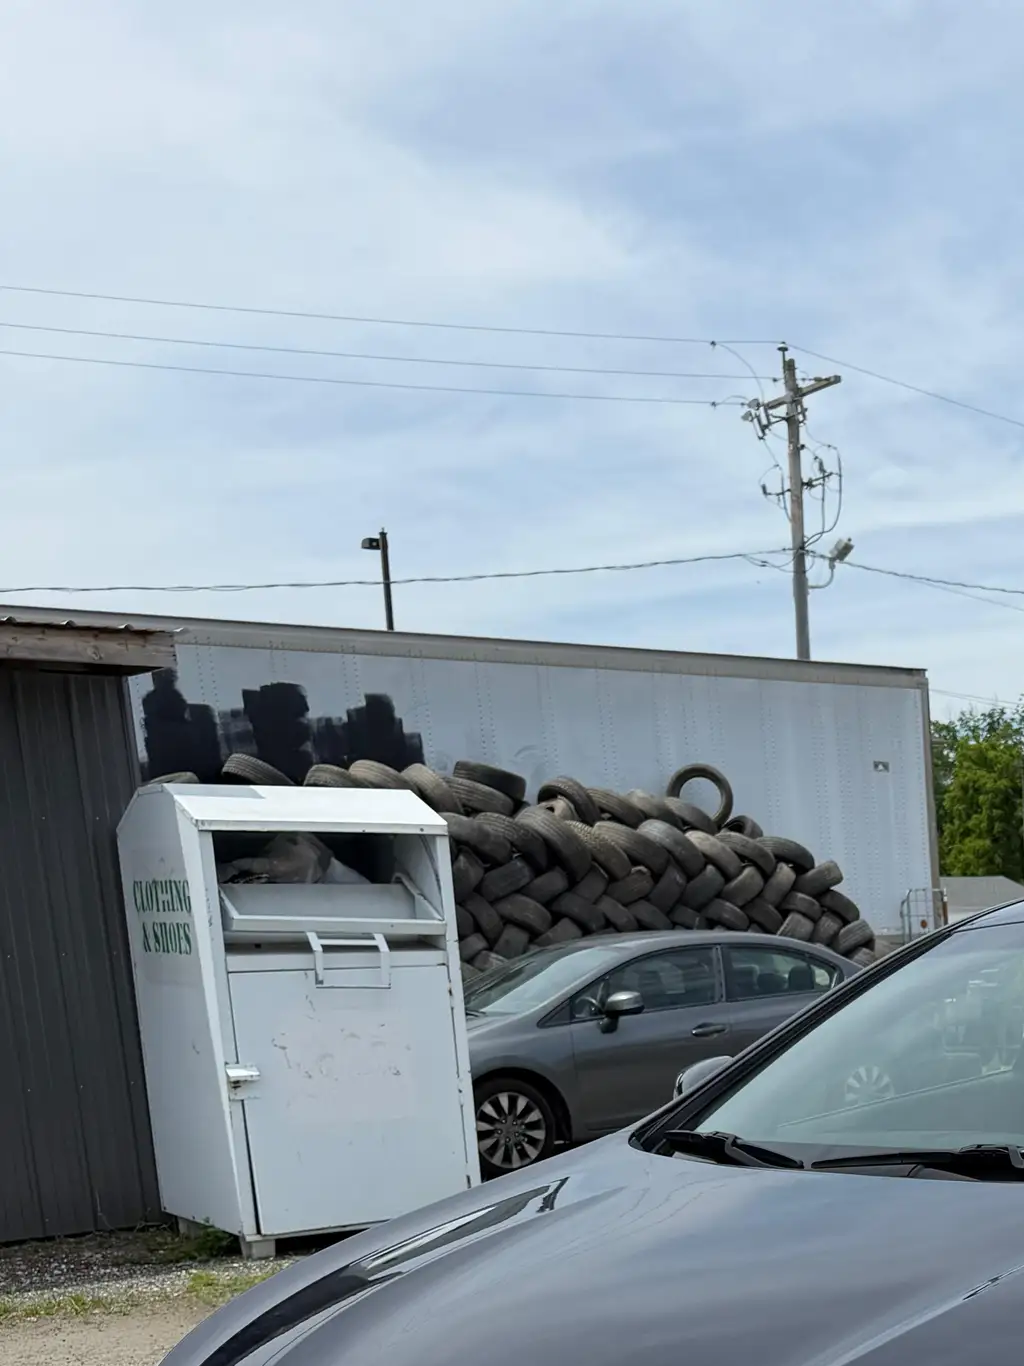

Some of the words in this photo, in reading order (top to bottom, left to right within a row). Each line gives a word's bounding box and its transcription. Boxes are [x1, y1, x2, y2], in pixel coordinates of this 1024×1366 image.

[132, 879, 192, 913] CLOTHING
[142, 921, 152, 953] &
[152, 921, 192, 955] SHOES
